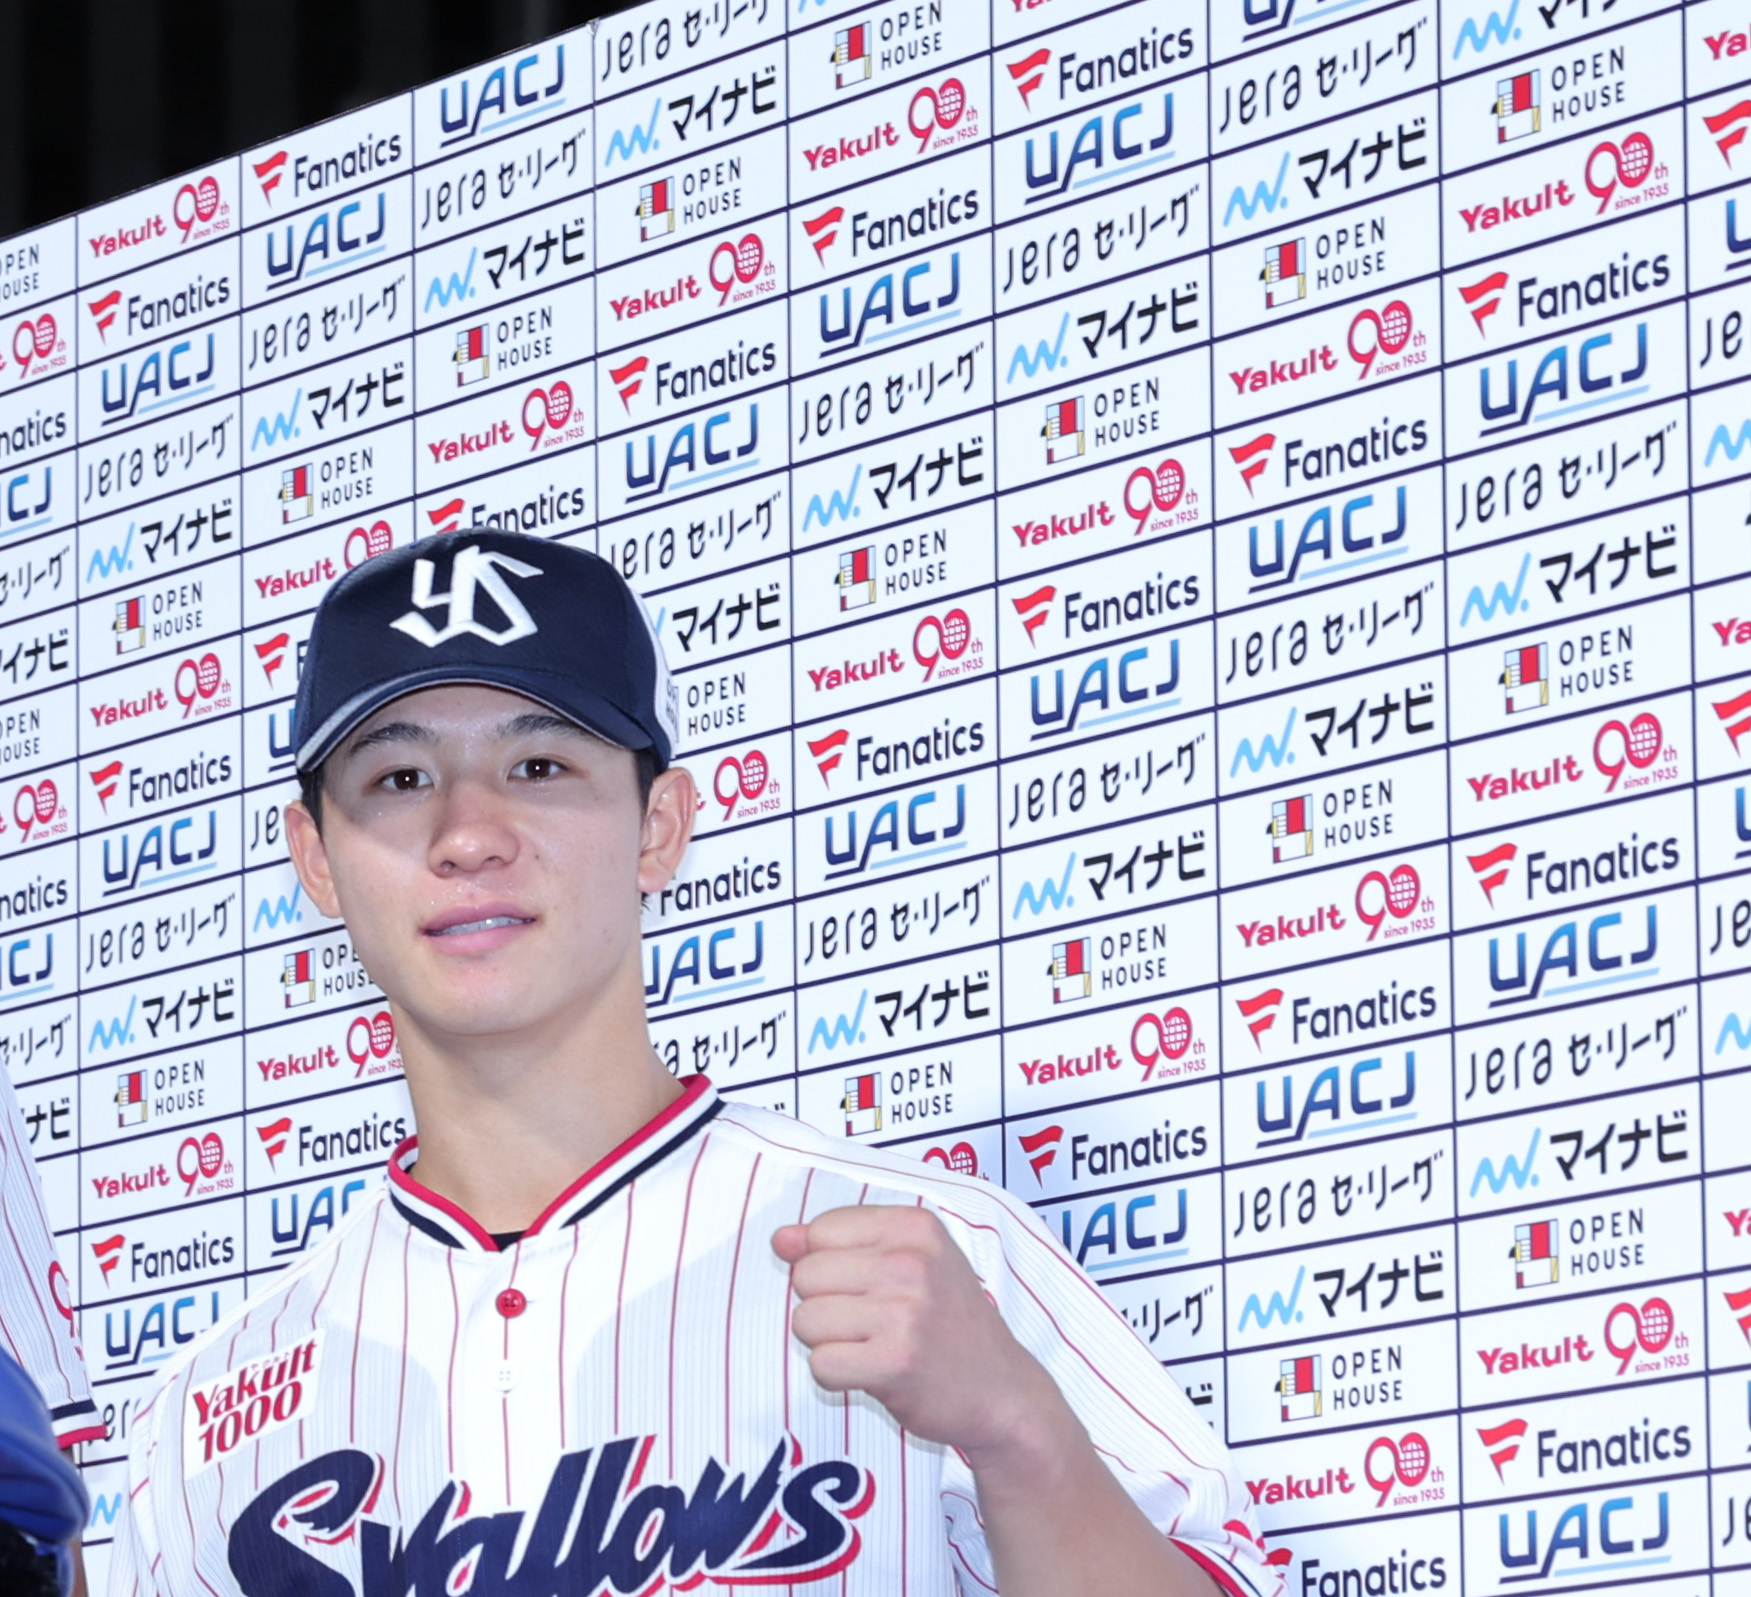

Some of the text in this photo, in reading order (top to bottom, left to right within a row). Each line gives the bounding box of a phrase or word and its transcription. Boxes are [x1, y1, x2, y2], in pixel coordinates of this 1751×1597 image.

[881, 1, 941, 41] OPEN
[882, 32, 941, 69] HOUSE
[1060, 27, 1193, 99] Fanatics
[1552, 47, 1623, 91] OPEN
[440, 45, 564, 148] UACJ
[668, 66, 775, 140] マイナビ
[1553, 81, 1624, 122] HOUSE
[295, 134, 401, 197] Fanatics
[803, 123, 899, 171] Yakult
[1025, 93, 1173, 205] UACJ
[1299, 117, 1426, 199] マイナビ
[683, 158, 740, 196] OPEN
[685, 189, 740, 223] HOUSE
[1459, 180, 1574, 232] Yakult
[89, 216, 166, 257] Yakult
[267, 193, 384, 291] UACJ
[853, 188, 978, 257] Fanatics
[1316, 217, 1384, 259] OPEN
[484, 218, 584, 289] マイナビ
[1318, 251, 1384, 289] HOUSE
[129, 276, 229, 335] Fanatics
[610, 275, 701, 320] Yakult
[820, 253, 959, 358] UACJ
[1519, 252, 1669, 326] Fanatics
[498, 307, 551, 343] OPEN
[1078, 282, 1198, 358] マイナビ
[102, 333, 214, 426] UACJ
[499, 337, 551, 370] HOUSE
[657, 341, 776, 405] Fanatics
[1229, 345, 1338, 394] Yakult
[1480, 323, 1647, 437] UACJ
[308, 362, 404, 430] マイナビ
[1095, 378, 1158, 417] OPEN
[428, 421, 514, 463] Yakult
[626, 404, 757, 504] UACJ
[1096, 411, 1158, 446] HOUSE
[1285, 417, 1427, 487] Fanatics
[869, 436, 983, 509] マイナビ
[141, 499, 232, 563] マイナビ
[885, 529, 945, 566] OPEN
[1012, 502, 1115, 547] Yakult
[1249, 486, 1406, 594] UACJ
[255, 558, 341, 598] Yakult
[887, 561, 946, 594] HOUSE
[1540, 524, 1676, 603] マイナビ
[153, 582, 201, 614] OPEN
[154, 610, 202, 640] HOUSE
[673, 583, 780, 652] マイナビ
[1065, 572, 1199, 638] Fanatics
[808, 649, 904, 691] Yakult
[1560, 626, 1631, 666] OPEN
[90, 689, 167, 726] Yakult
[1030, 640, 1179, 741] UACJ
[1561, 661, 1632, 696] HOUSE
[1305, 682, 1434, 756] マイナビ
[130, 752, 231, 807] Fanatics
[858, 719, 984, 781] Fanatics
[1467, 756, 1583, 801] Yakult
[1324, 780, 1391, 817] OPEN
[103, 811, 215, 897] UACJ
[825, 784, 965, 881] UACJ
[1325, 814, 1392, 847] HOUSE
[1084, 830, 1205, 900] マイナビ
[1527, 833, 1679, 900] Fanatics
[1237, 905, 1346, 947] Yakult
[1489, 905, 1657, 1008] UACJ
[143, 979, 234, 1038] マイナビ
[875, 970, 989, 1037] マイナビ
[1293, 981, 1436, 1044] Fanatics
[258, 1045, 339, 1081] Yakult
[1019, 1045, 1122, 1085] Yakult
[1256, 1051, 1415, 1149] UACJ
[299, 1113, 407, 1166] Fanatics
[1072, 1120, 1207, 1180] Fanatics
[1550, 1110, 1687, 1180] マイナビ
[92, 1165, 170, 1198] Yakult
[1570, 1209, 1643, 1244] OPEN
[132, 1232, 234, 1282] Fanatics
[1314, 1251, 1443, 1317] マイナビ
[1572, 1244, 1643, 1275] HOUSE
[193, 1338, 317, 1426] Yakult
[1477, 1335, 1594, 1374] Yakult
[199, 1381, 302, 1463] 1000
[1538, 1418, 1691, 1477] Fanatics
[1246, 1468, 1354, 1507] Yakult
[1499, 1492, 1669, 1584] UACJ
